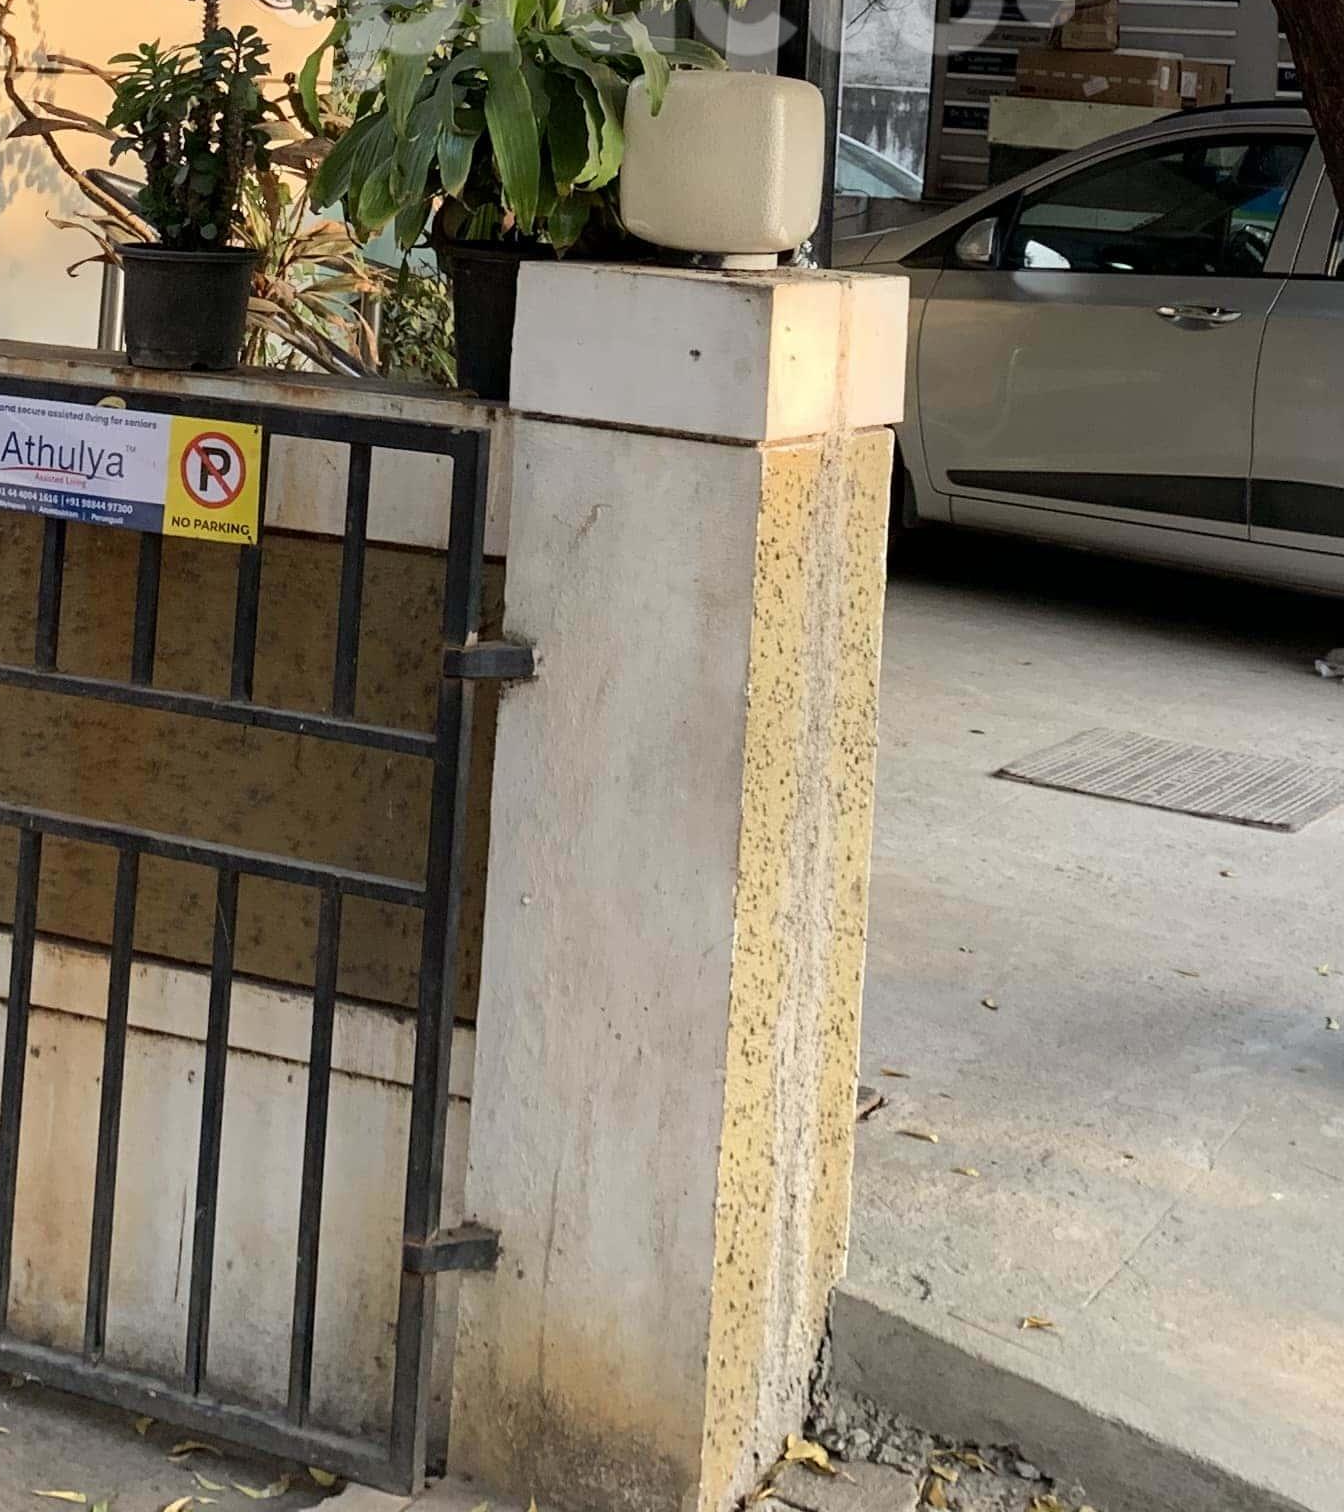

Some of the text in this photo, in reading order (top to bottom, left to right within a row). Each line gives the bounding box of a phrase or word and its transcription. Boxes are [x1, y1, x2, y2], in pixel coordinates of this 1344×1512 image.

[0, 403, 17, 414] and
[17, 406, 46, 417] secure
[47, 408, 84, 422] assisted
[85, 413, 109, 427] living
[110, 416, 124, 426] for
[125, 419, 157, 431] seniors
[0, 430, 125, 480] Athulya
[170, 515, 250, 537] NO PARKING
